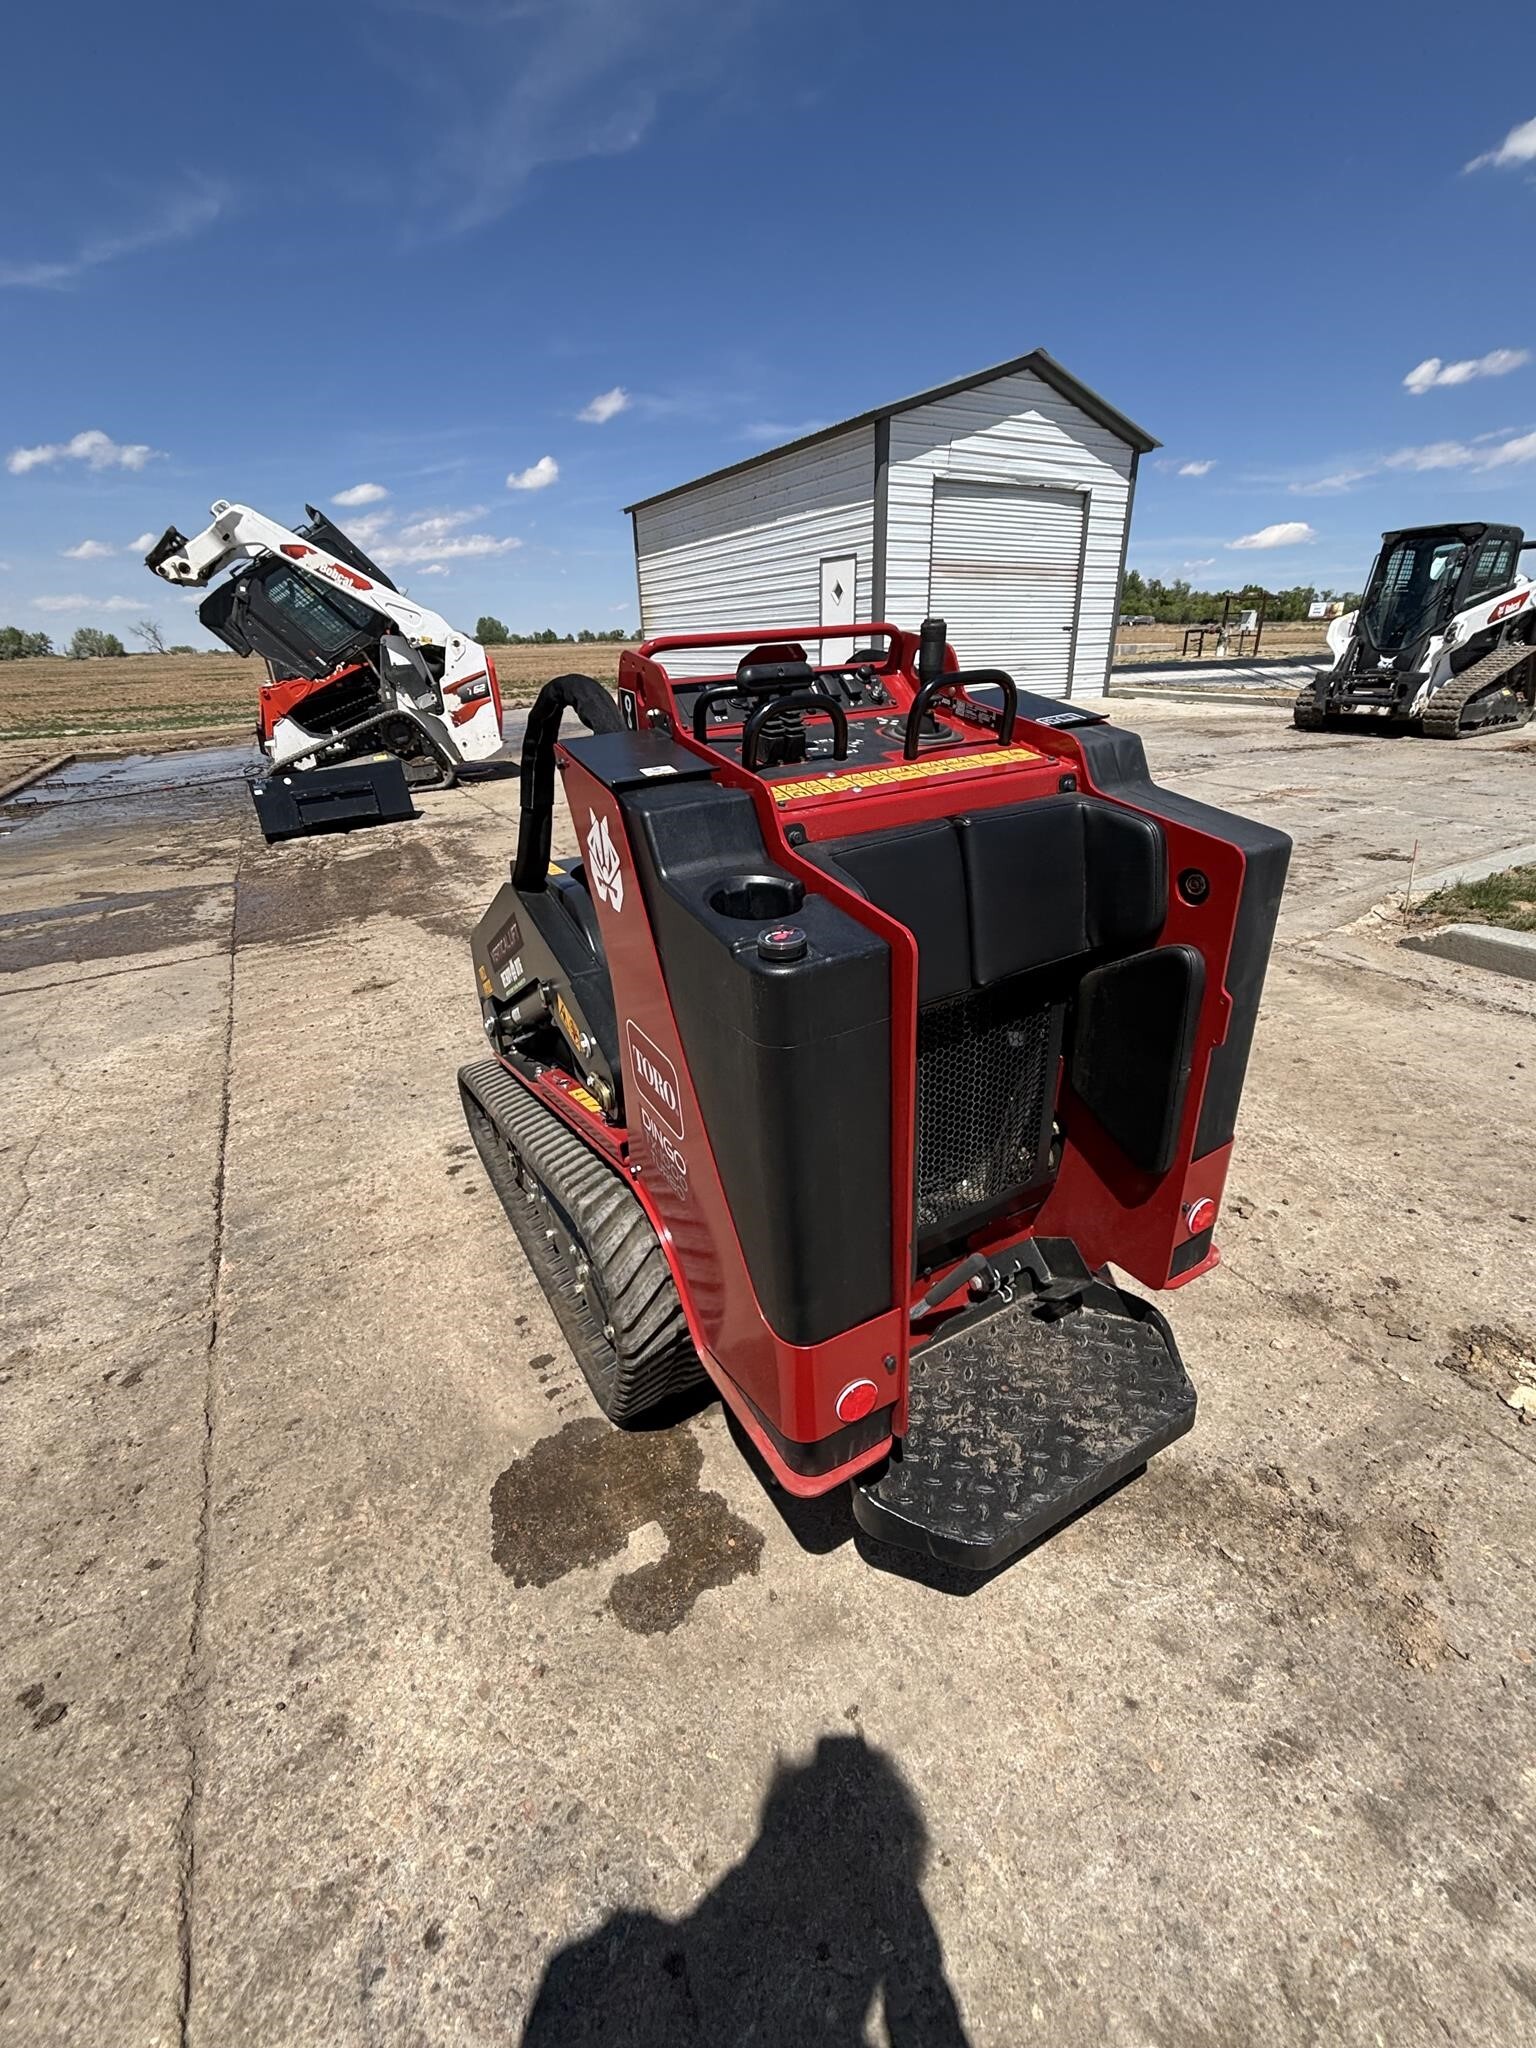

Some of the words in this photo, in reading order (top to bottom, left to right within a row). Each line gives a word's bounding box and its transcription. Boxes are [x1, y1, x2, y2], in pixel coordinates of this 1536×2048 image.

[319, 563, 354, 588] Bobcat
[632, 1044, 677, 1111] TORO
[641, 1107, 687, 1175] DINGO
